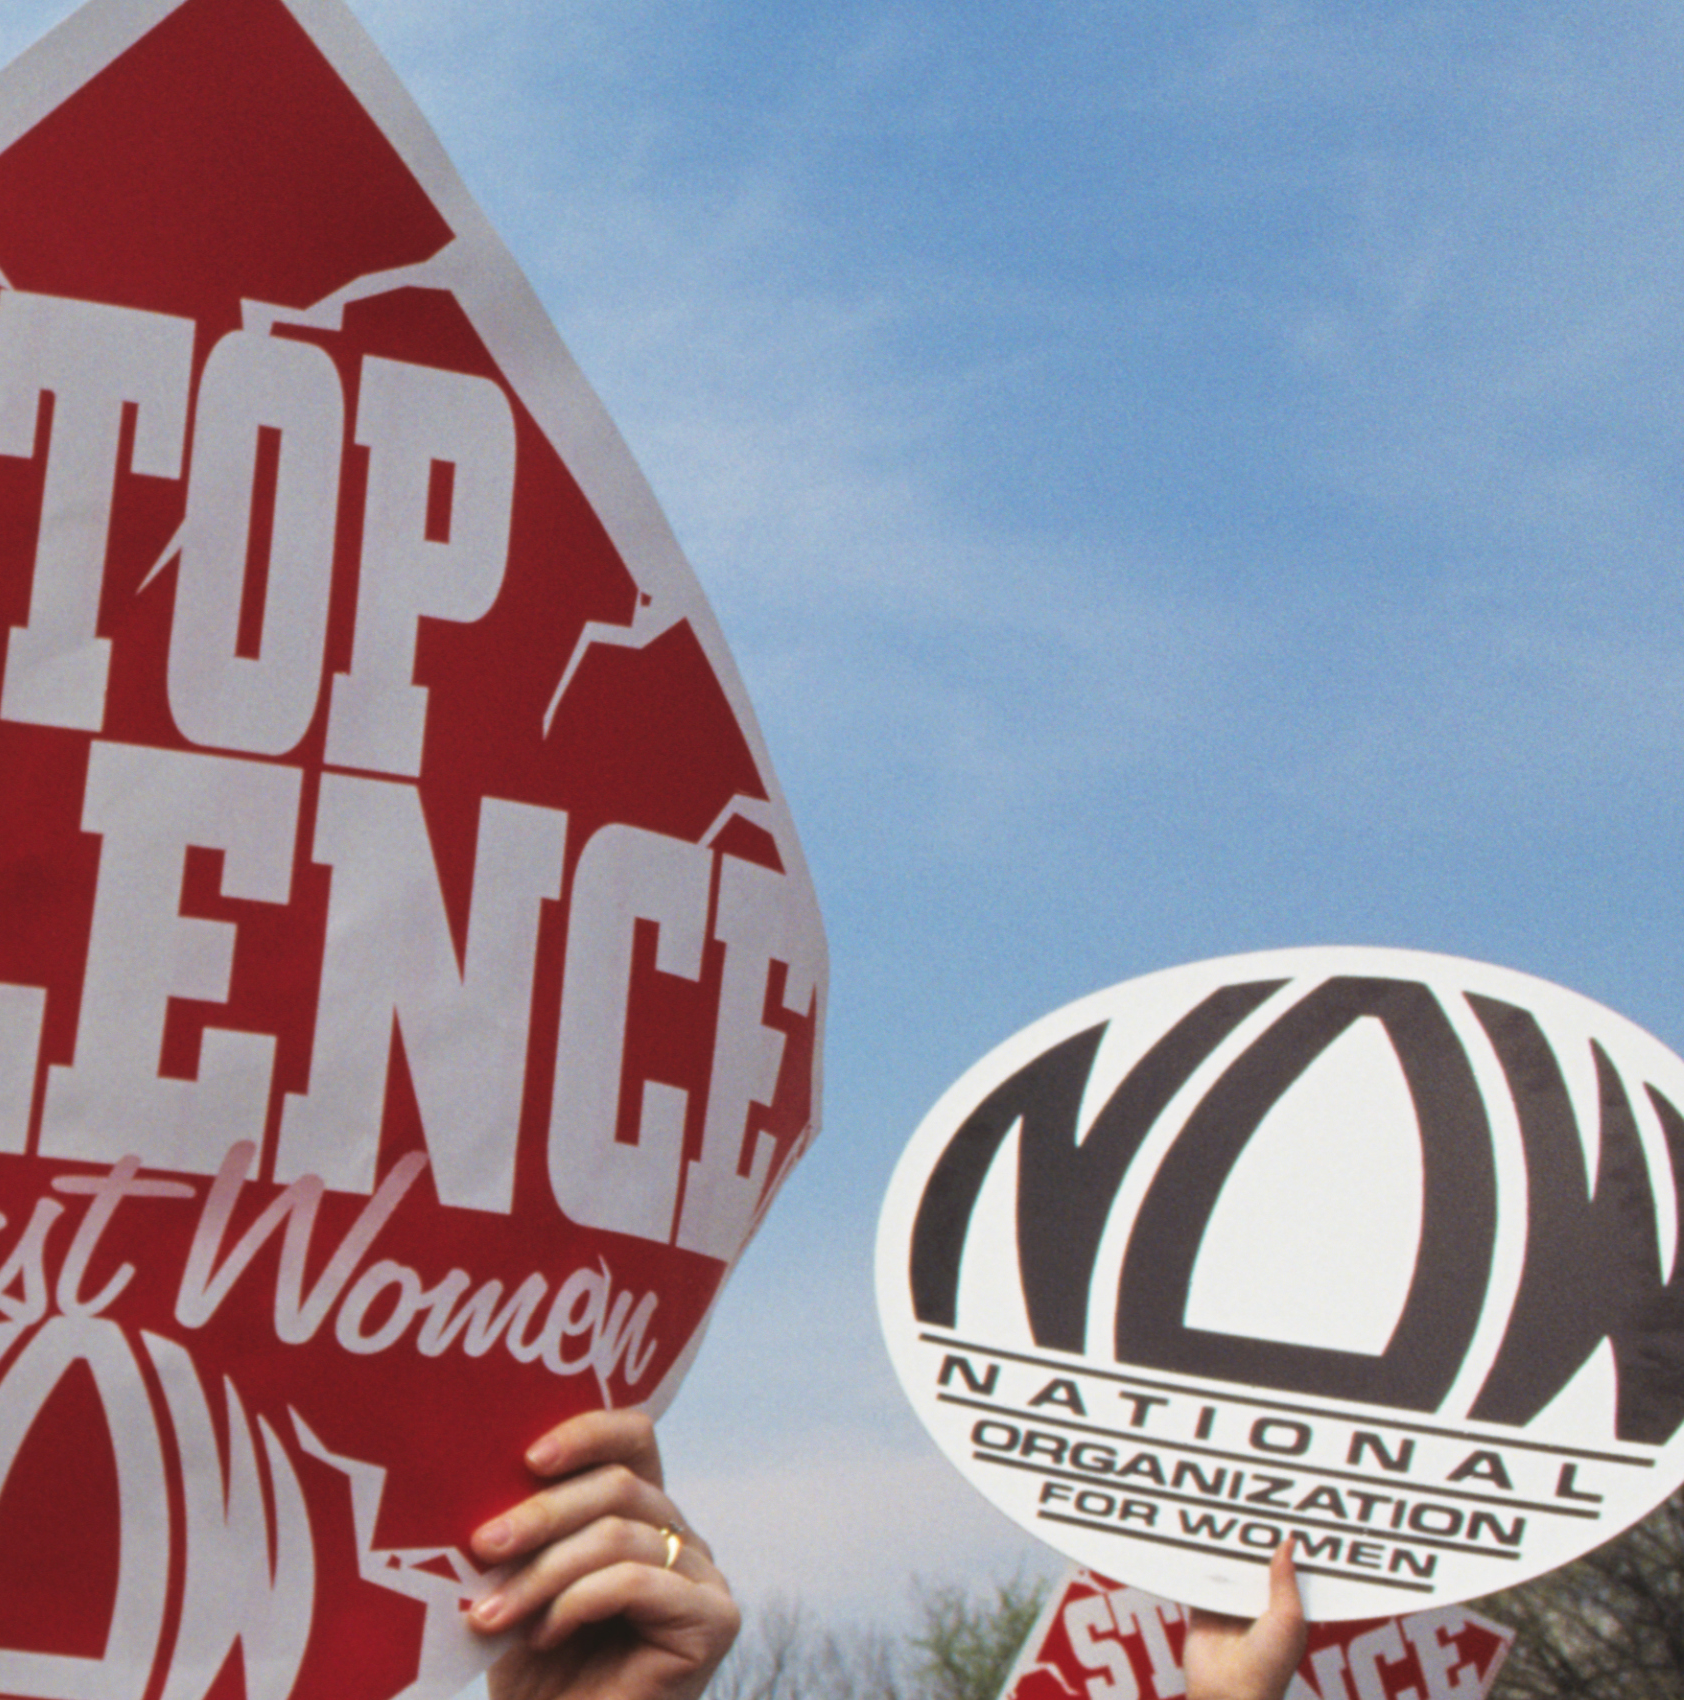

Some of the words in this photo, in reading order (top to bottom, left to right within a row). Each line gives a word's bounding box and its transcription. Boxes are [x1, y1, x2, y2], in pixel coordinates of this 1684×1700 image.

[173, 1140, 656, 1374] Women
[907, 974, 1684, 1448] NOW
[936, 1352, 1605, 1505] NATIONAL
[969, 1416, 1528, 1549] ORGANIZATION
[1037, 1480, 1160, 1527] FOR
[1176, 1507, 1439, 1580] WOMEN
